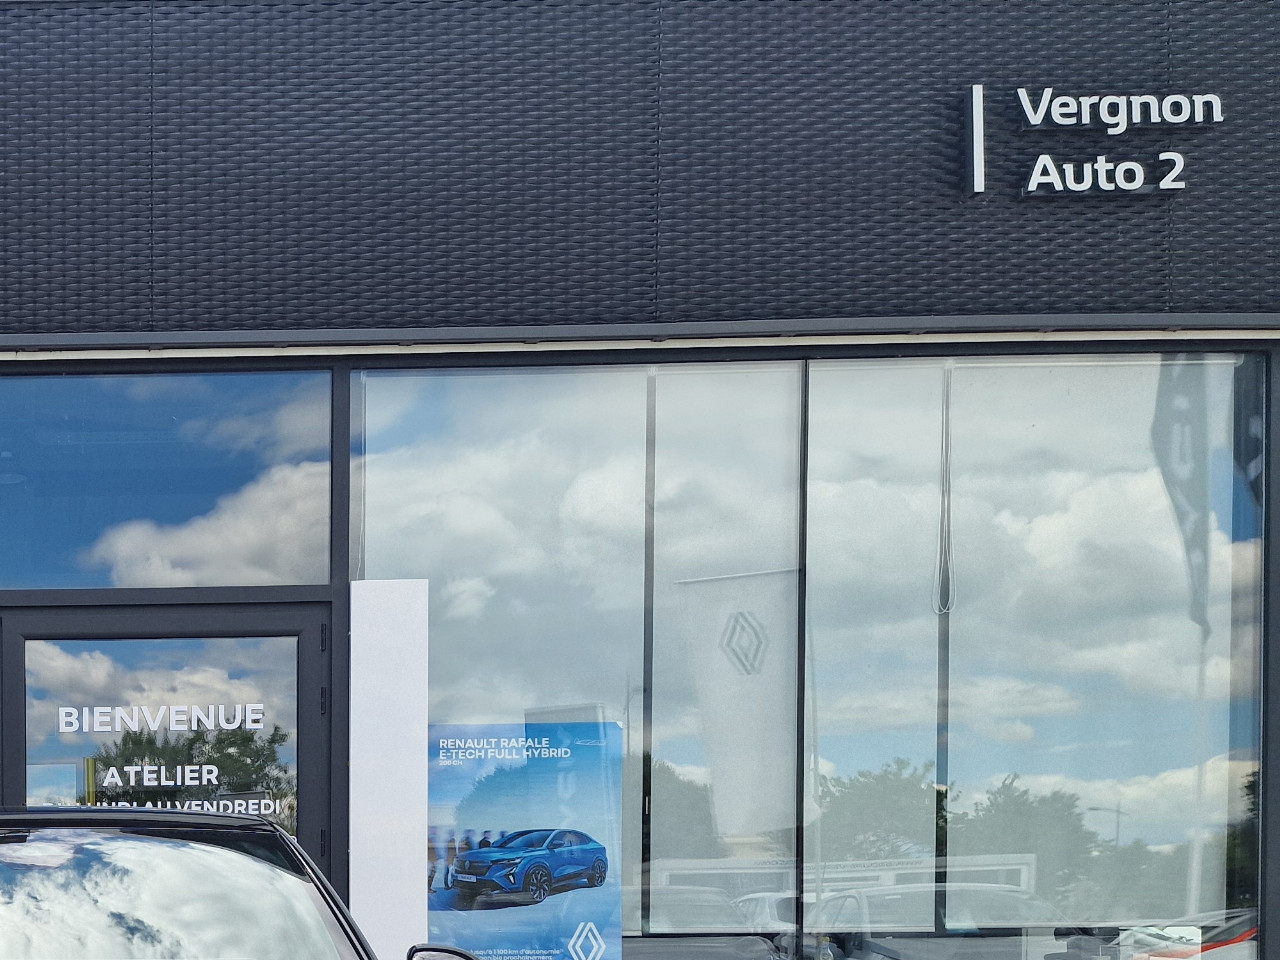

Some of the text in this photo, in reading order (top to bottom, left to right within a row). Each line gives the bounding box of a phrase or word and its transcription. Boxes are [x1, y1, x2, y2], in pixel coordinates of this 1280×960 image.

[1017, 87, 1224, 135] Vergnon
[1027, 152, 1186, 192] Auto 2
[58, 703, 265, 733] BIENVENUE
[439, 737, 550, 749] RENAULT RAFALE
[439, 747, 571, 760] E-TECH FULL HYBRID
[102, 764, 220, 787] ATELIER
[174, 799, 281, 815] VENDREDI
